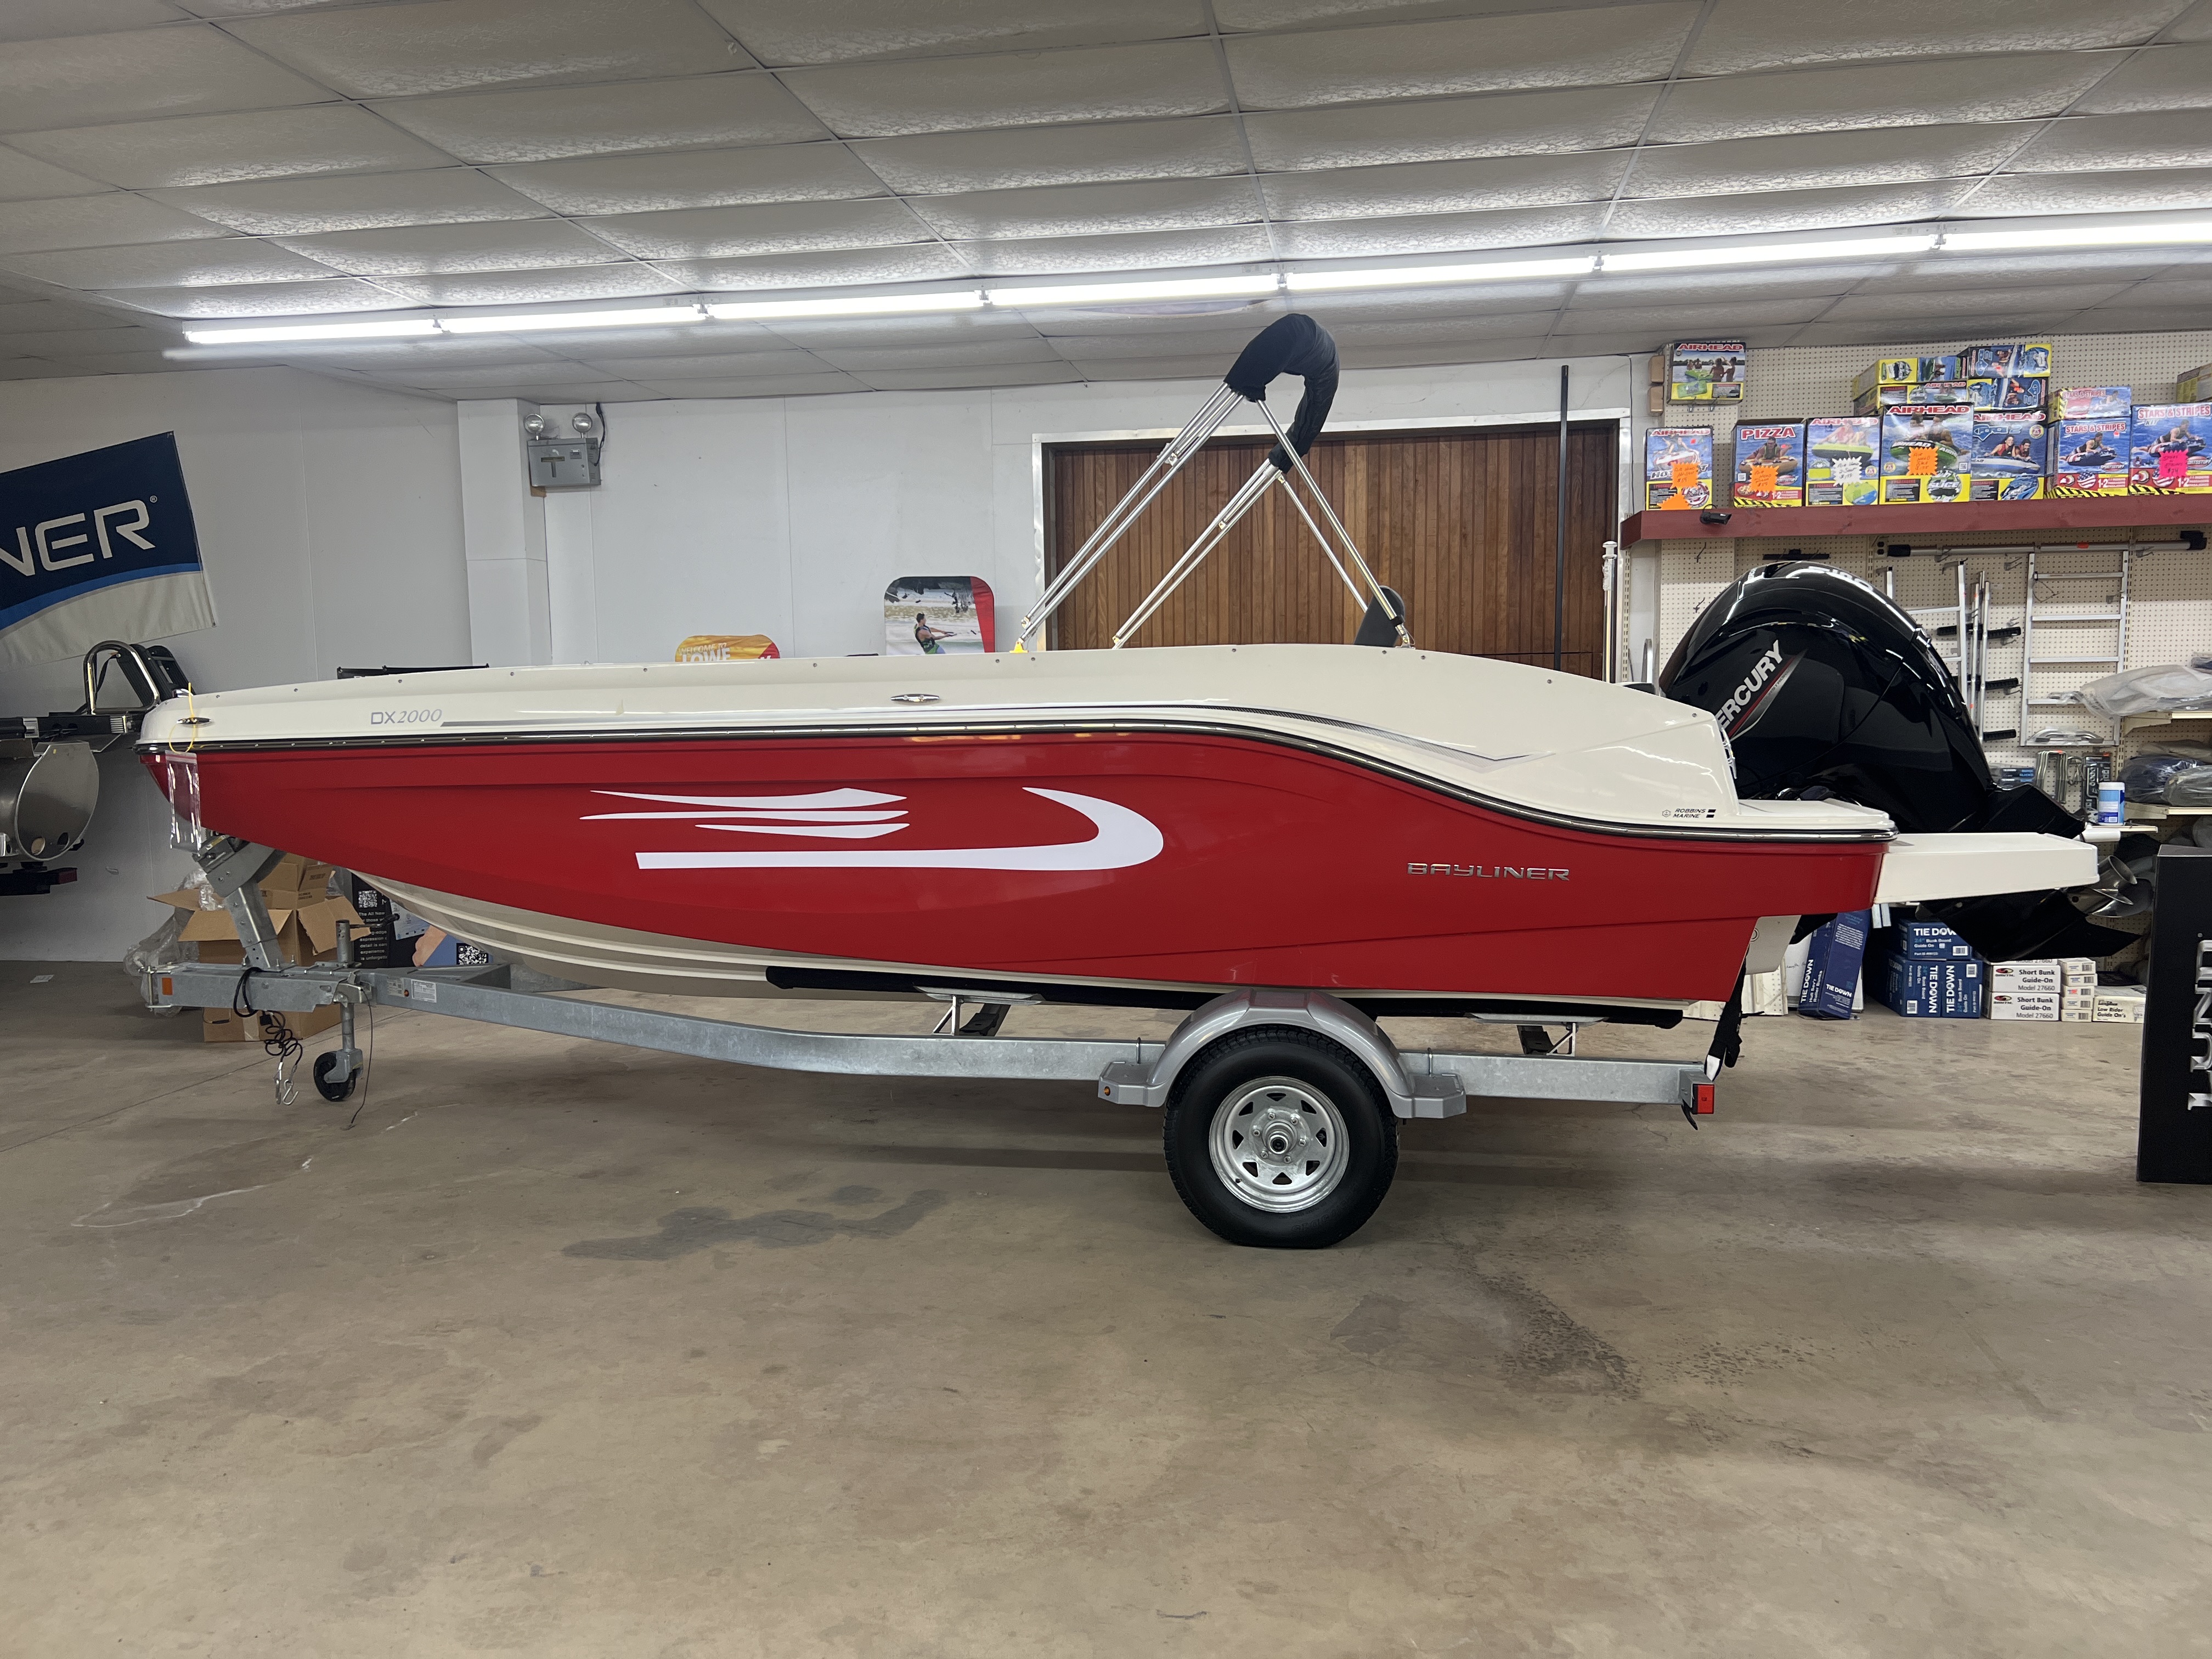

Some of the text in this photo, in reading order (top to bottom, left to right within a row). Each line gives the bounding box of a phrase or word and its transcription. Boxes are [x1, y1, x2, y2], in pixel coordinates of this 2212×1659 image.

[1886, 406, 1971, 415] AIRHEAD
[1973, 413, 2046, 421] AIRHEAD
[2138, 405, 2211, 419] STARS & STRIPES
[1651, 428, 1711, 436] AIRHEAD
[1741, 427, 1796, 440] PIZZA
[2066, 425, 2088, 433] STARS
[2096, 423, 2126, 432] STRIPES
[1715, 640, 1783, 732] ERCURY
[1407, 863, 1570, 881] BAYLINER
[1914, 928, 1957, 936] TIE DOW
[1803, 959, 1814, 988] DOWN
[1826, 984, 1852, 997] TIE DOWN
[1929, 965, 1938, 1013] TIE DOWN
[1946, 965, 1955, 1013] TIE DOWN
